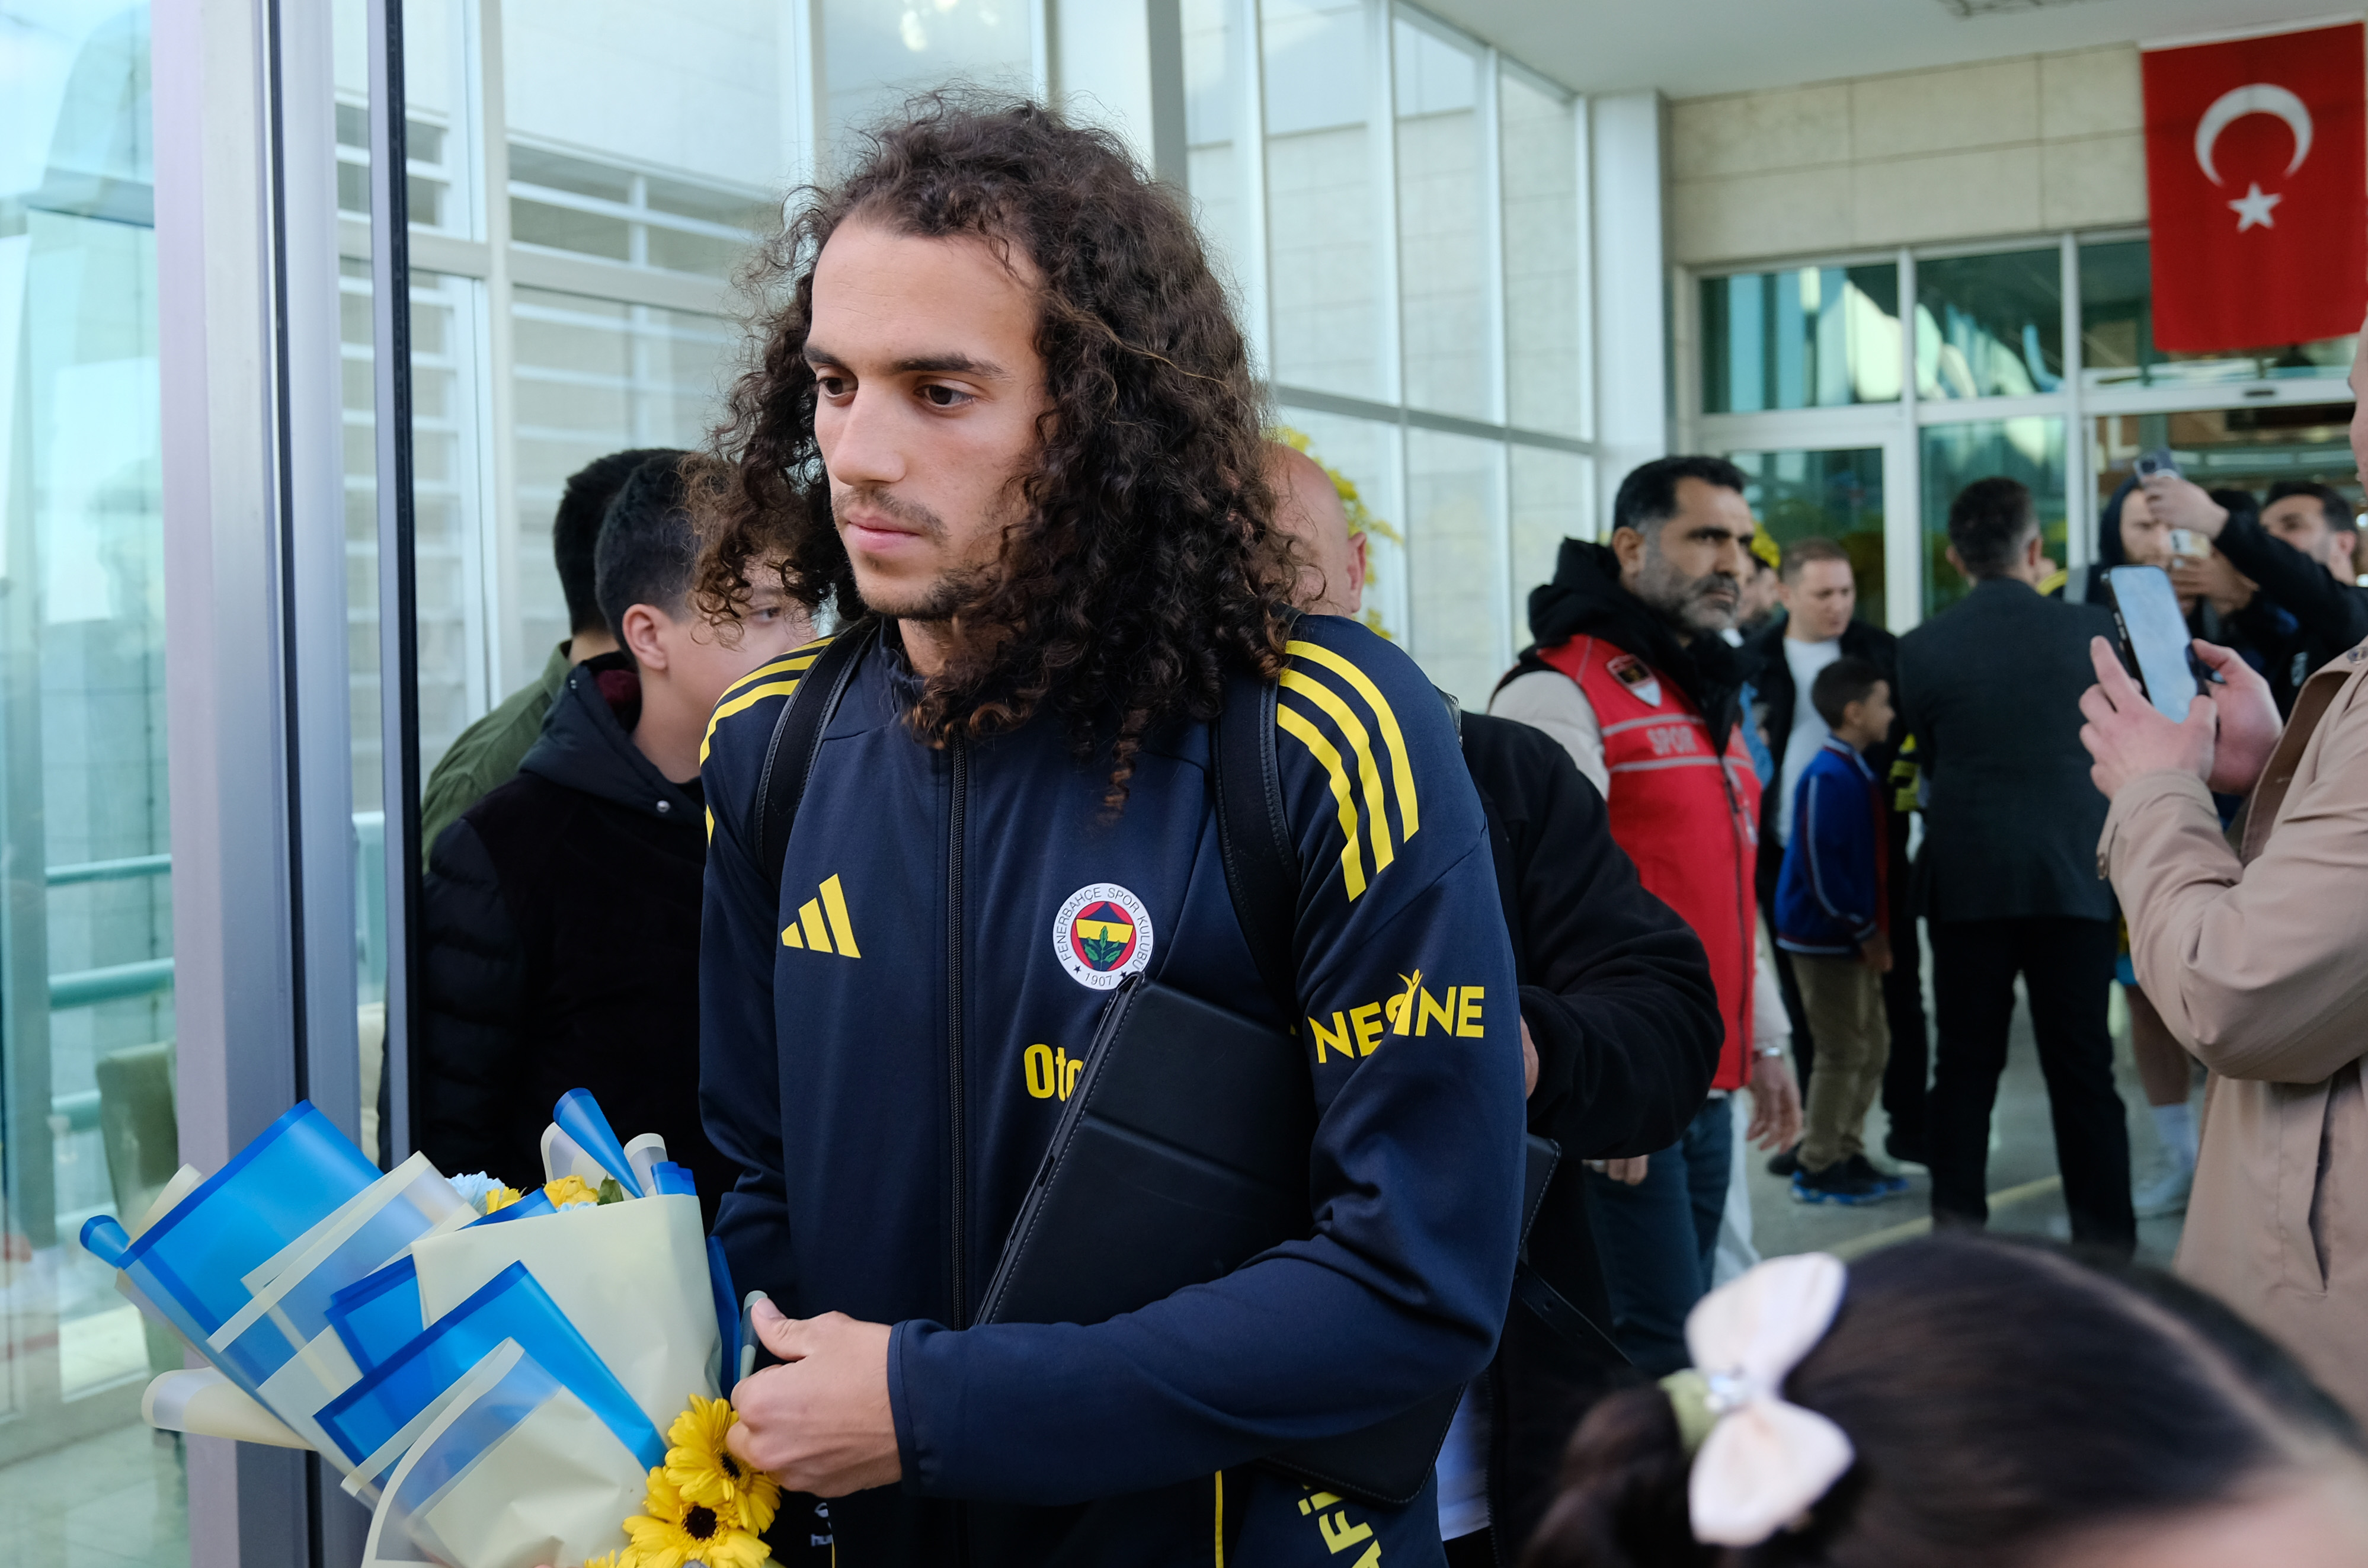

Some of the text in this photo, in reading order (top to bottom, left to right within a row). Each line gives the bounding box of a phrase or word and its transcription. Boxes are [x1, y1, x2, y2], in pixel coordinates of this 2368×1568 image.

[1647, 725, 1697, 756] SPOR
[1056, 887, 1151, 971] FENERBAHÇE SPOR KULÜBÜ
[1085, 972, 1112, 987] 1907
